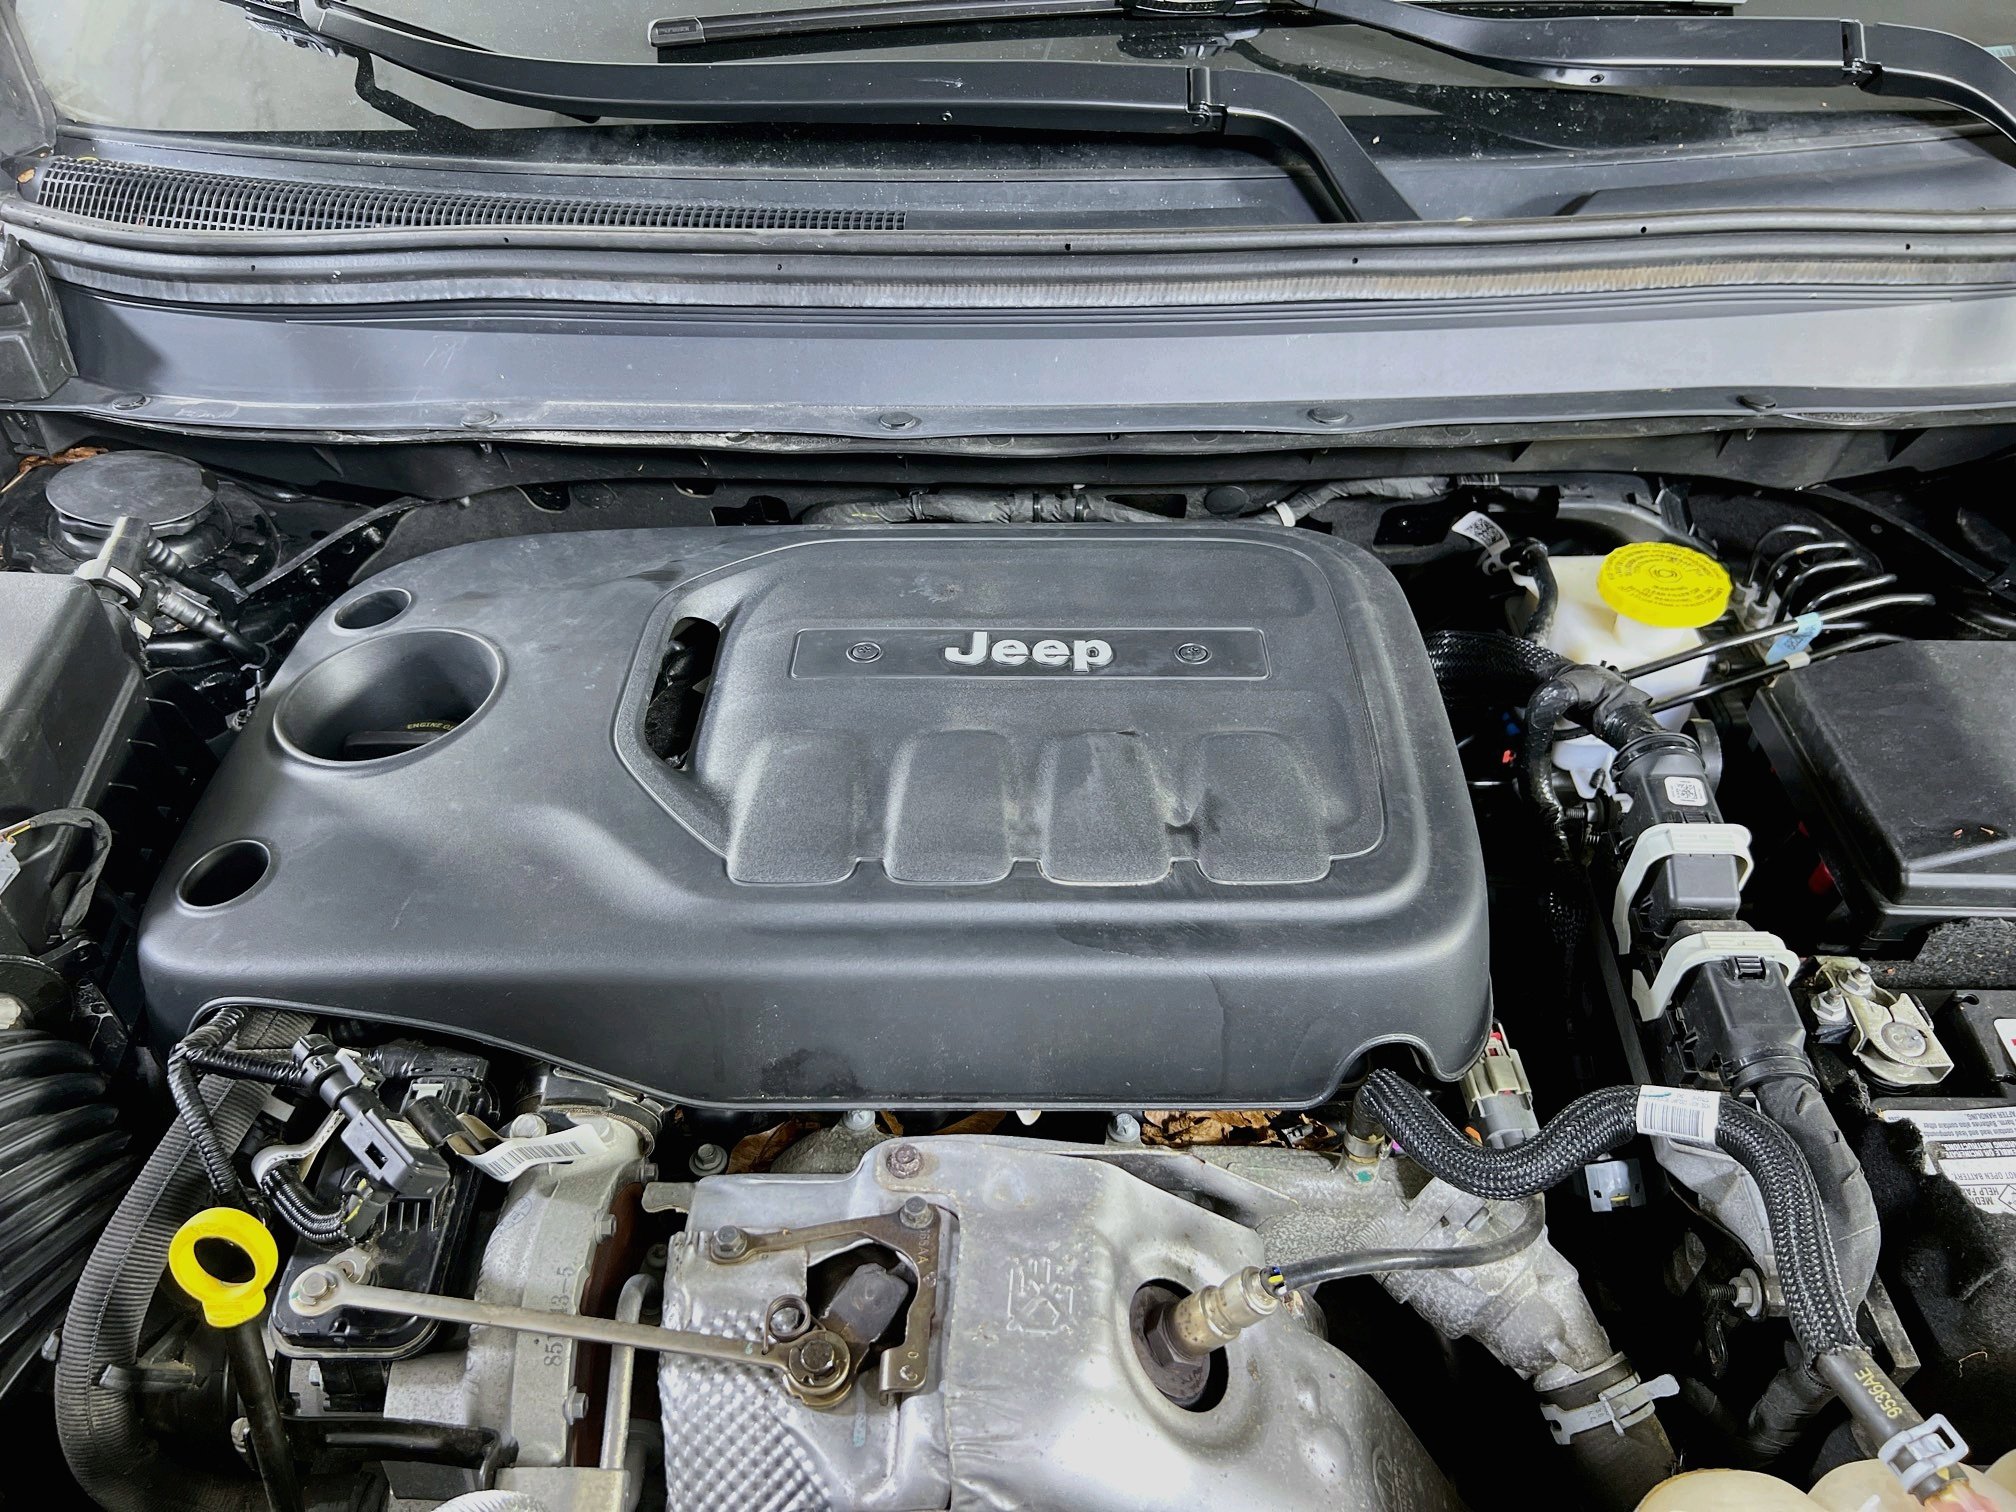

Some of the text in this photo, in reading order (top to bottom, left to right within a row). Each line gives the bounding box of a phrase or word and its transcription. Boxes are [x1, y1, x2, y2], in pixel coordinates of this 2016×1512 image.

[944, 631, 1114, 673] Jeep
[406, 722, 443, 730] ENGINE
[1997, 1110, 2016, 1119] AFTER
[1951, 1172, 1983, 1180] BATTERY.
[1984, 1171, 2003, 1180] OPEN
[1964, 1187, 1999, 1196] HELP FA
[1970, 1196, 1994, 1206] MEDI
[1854, 1366, 1903, 1419] 9536AE
